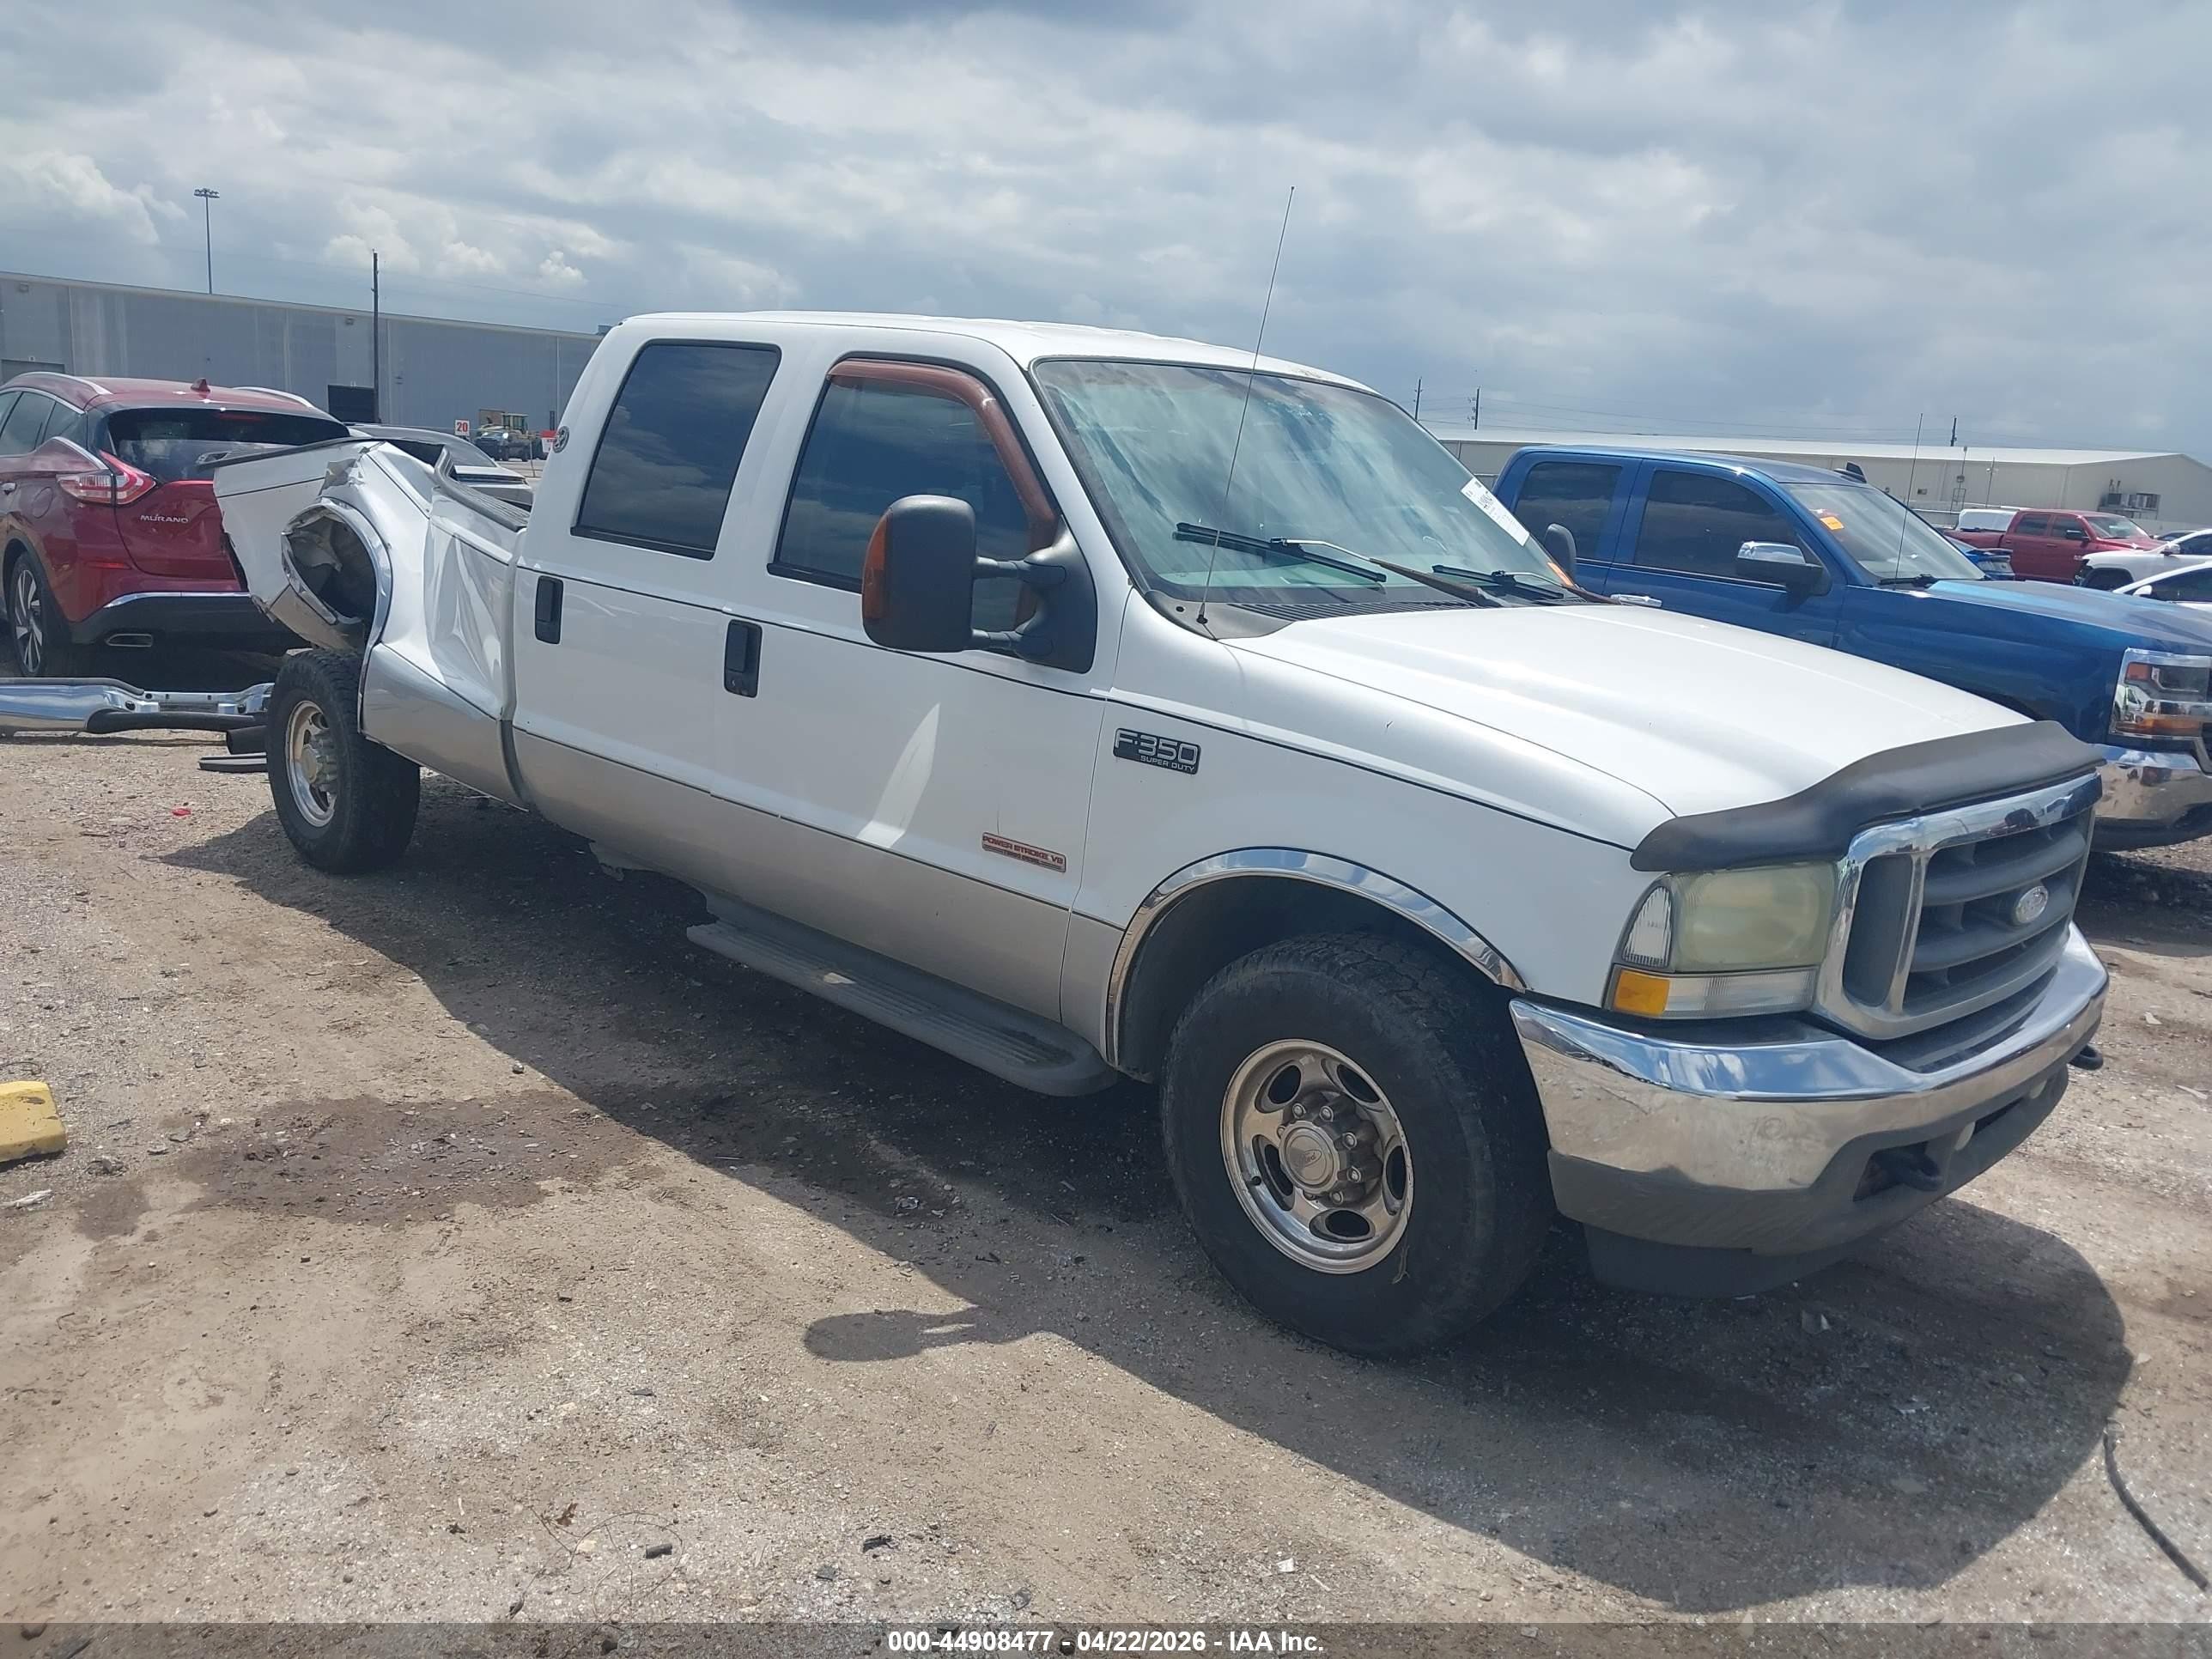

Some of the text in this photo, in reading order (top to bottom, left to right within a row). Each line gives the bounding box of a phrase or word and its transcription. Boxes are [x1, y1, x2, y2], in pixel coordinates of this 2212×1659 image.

[457, 422, 468, 433] 20
[140, 514, 189, 523] MURANO
[1140, 756, 1194, 772] SUPER DUTY
[982, 836, 1013, 850] POWER
[1014, 844, 1048, 860] STROKE
